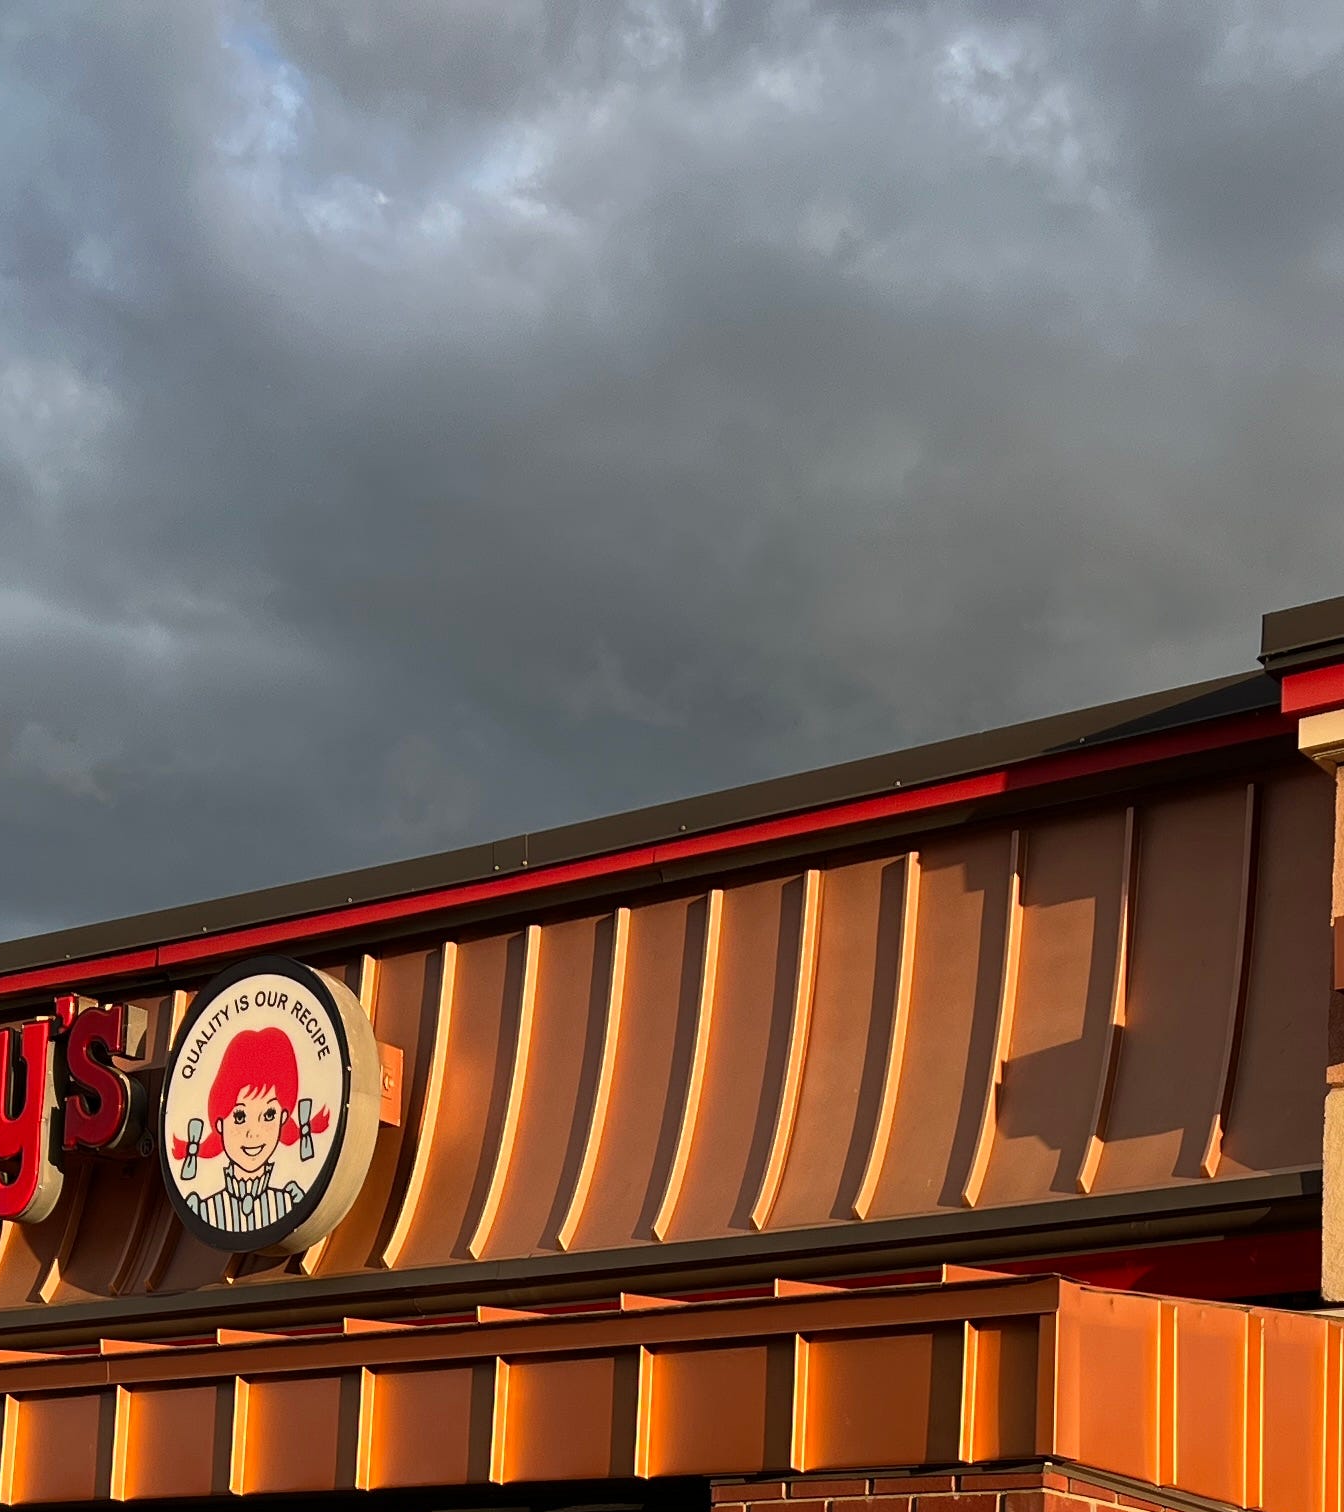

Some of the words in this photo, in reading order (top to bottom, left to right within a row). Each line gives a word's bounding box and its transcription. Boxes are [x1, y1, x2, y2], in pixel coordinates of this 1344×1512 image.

[181, 1005, 230, 1079] QUALITY
[234, 994, 250, 1014] IS
[254, 990, 289, 1011] OUR
[290, 1000, 331, 1061] RECIPE
